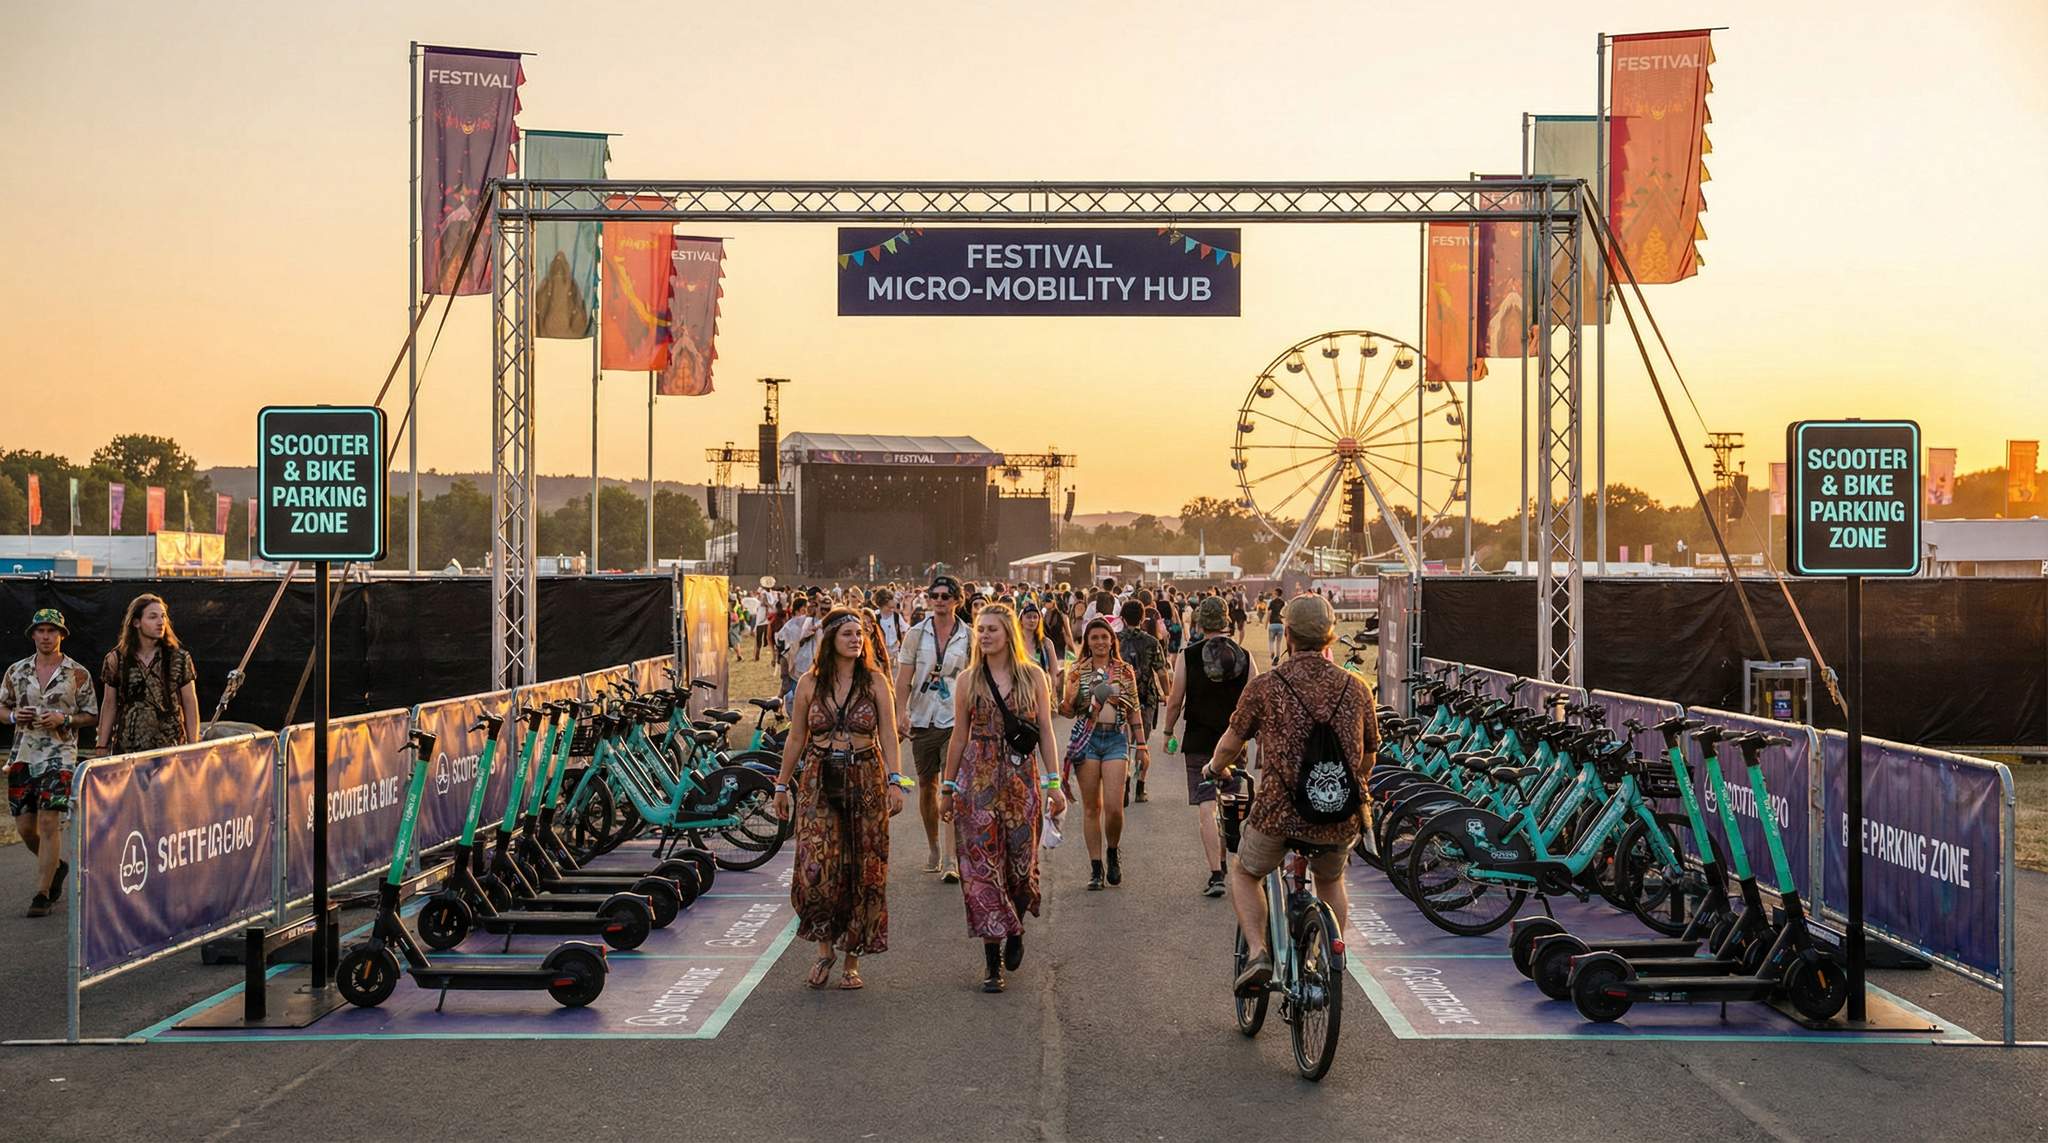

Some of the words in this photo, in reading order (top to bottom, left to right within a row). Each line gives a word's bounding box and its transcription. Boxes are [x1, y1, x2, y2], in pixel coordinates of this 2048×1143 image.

[1617, 54, 1703, 71] FESTIVAL
[429, 69, 513, 89] FESTIVAL
[671, 249, 719, 263] ESTIVAL
[966, 244, 1113, 269] FESTIVAL
[868, 276, 1136, 301] MICRO-MOBILITY
[1144, 276, 1212, 301] HUB
[270, 434, 369, 456] SCOOTER
[894, 453, 936, 464] FESTIVAL
[1807, 448, 1908, 470] SCOOTER
[283, 460, 301, 481] &
[306, 460, 356, 481] BIKE
[1820, 474, 1839, 496] &
[1844, 474, 1894, 496] BIKE
[272, 486, 367, 507] PARKING
[1810, 501, 1905, 522] PARKING
[290, 512, 348, 533] ZONE
[1829, 527, 1887, 549] ZONE
[379, 776, 398, 808] BIKE
[1842, 811, 1869, 854] BE
[1870, 819, 1927, 875] PARKING
[1929, 837, 1970, 889] ZONE
